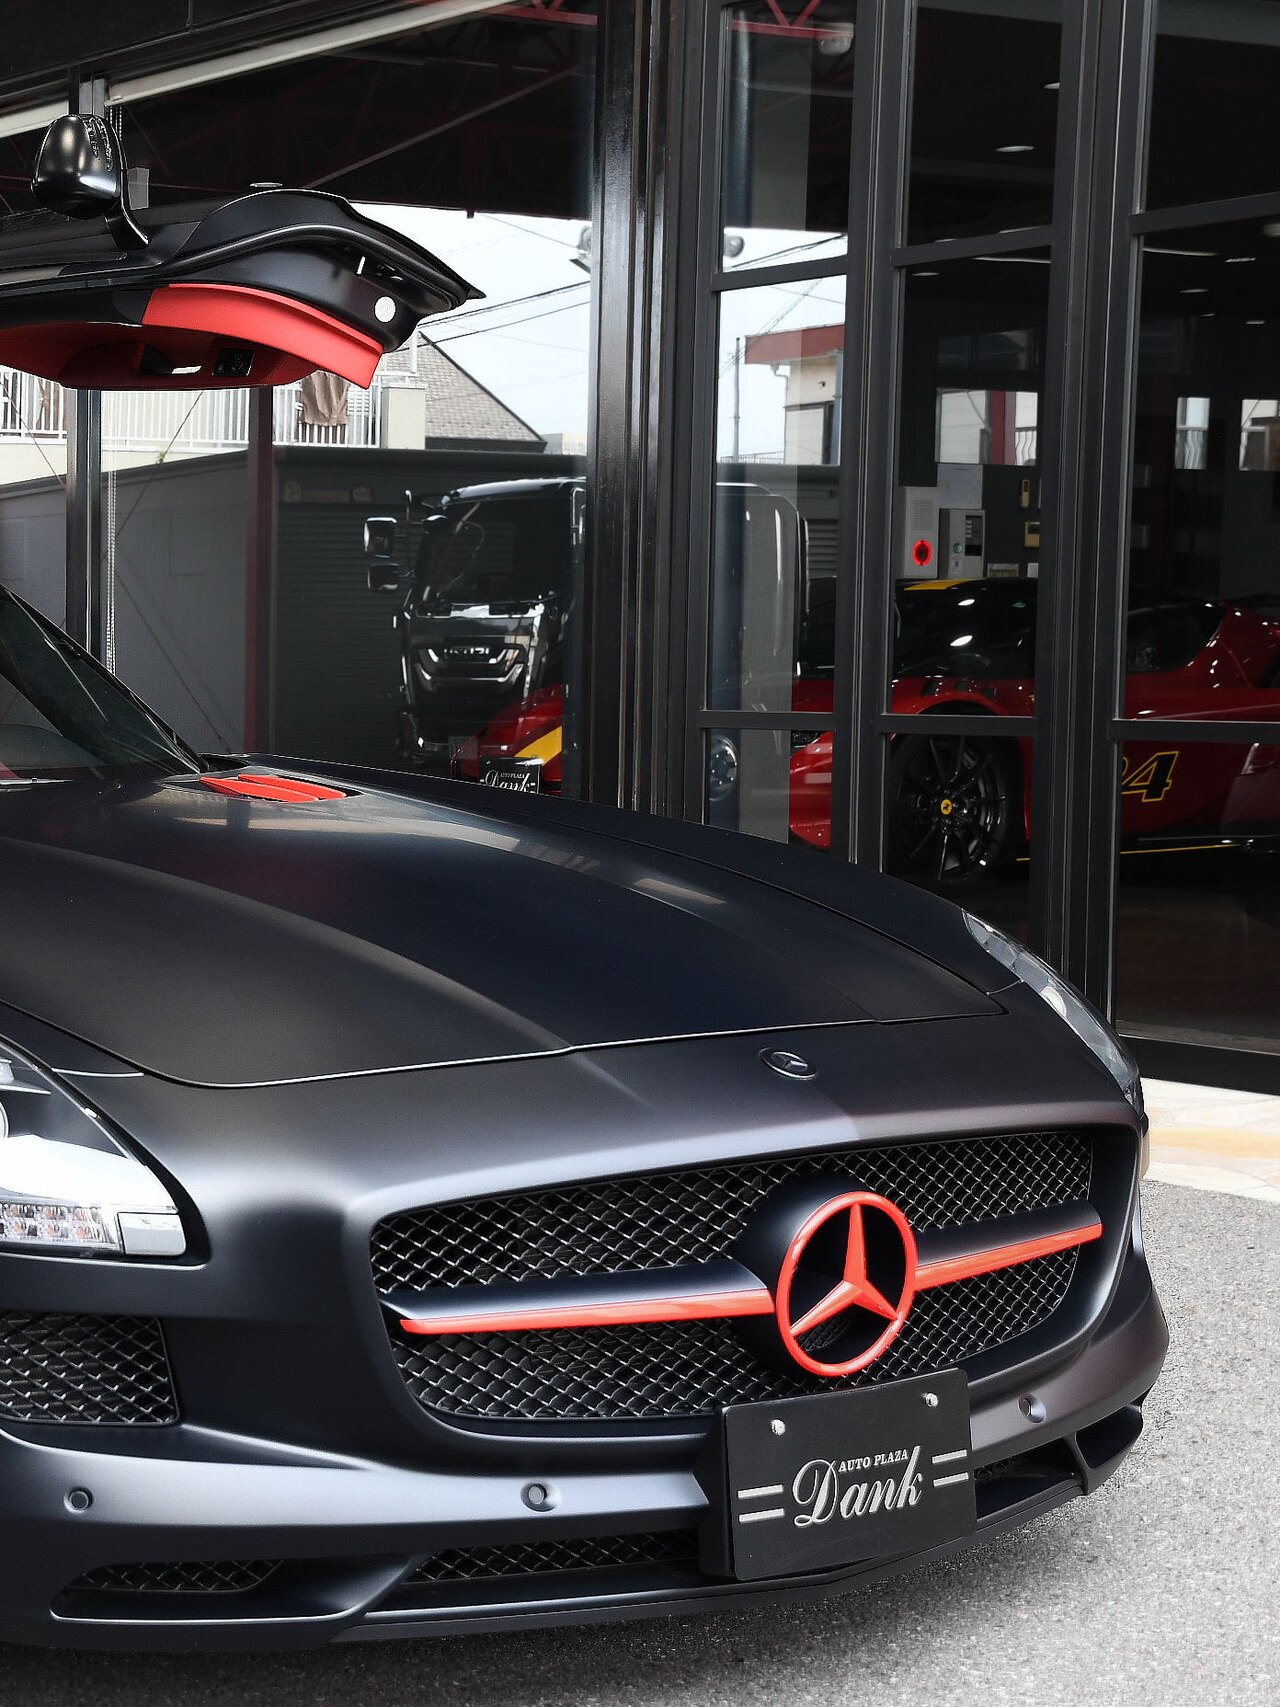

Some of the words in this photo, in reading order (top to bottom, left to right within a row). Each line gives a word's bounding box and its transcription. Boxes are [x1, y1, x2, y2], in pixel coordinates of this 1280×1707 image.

[1121, 750, 1180, 803] 4
[792, 1446, 923, 1527] Dank
[838, 1457, 871, 1473] AUTO
[873, 1449, 909, 1466] PLAZA
